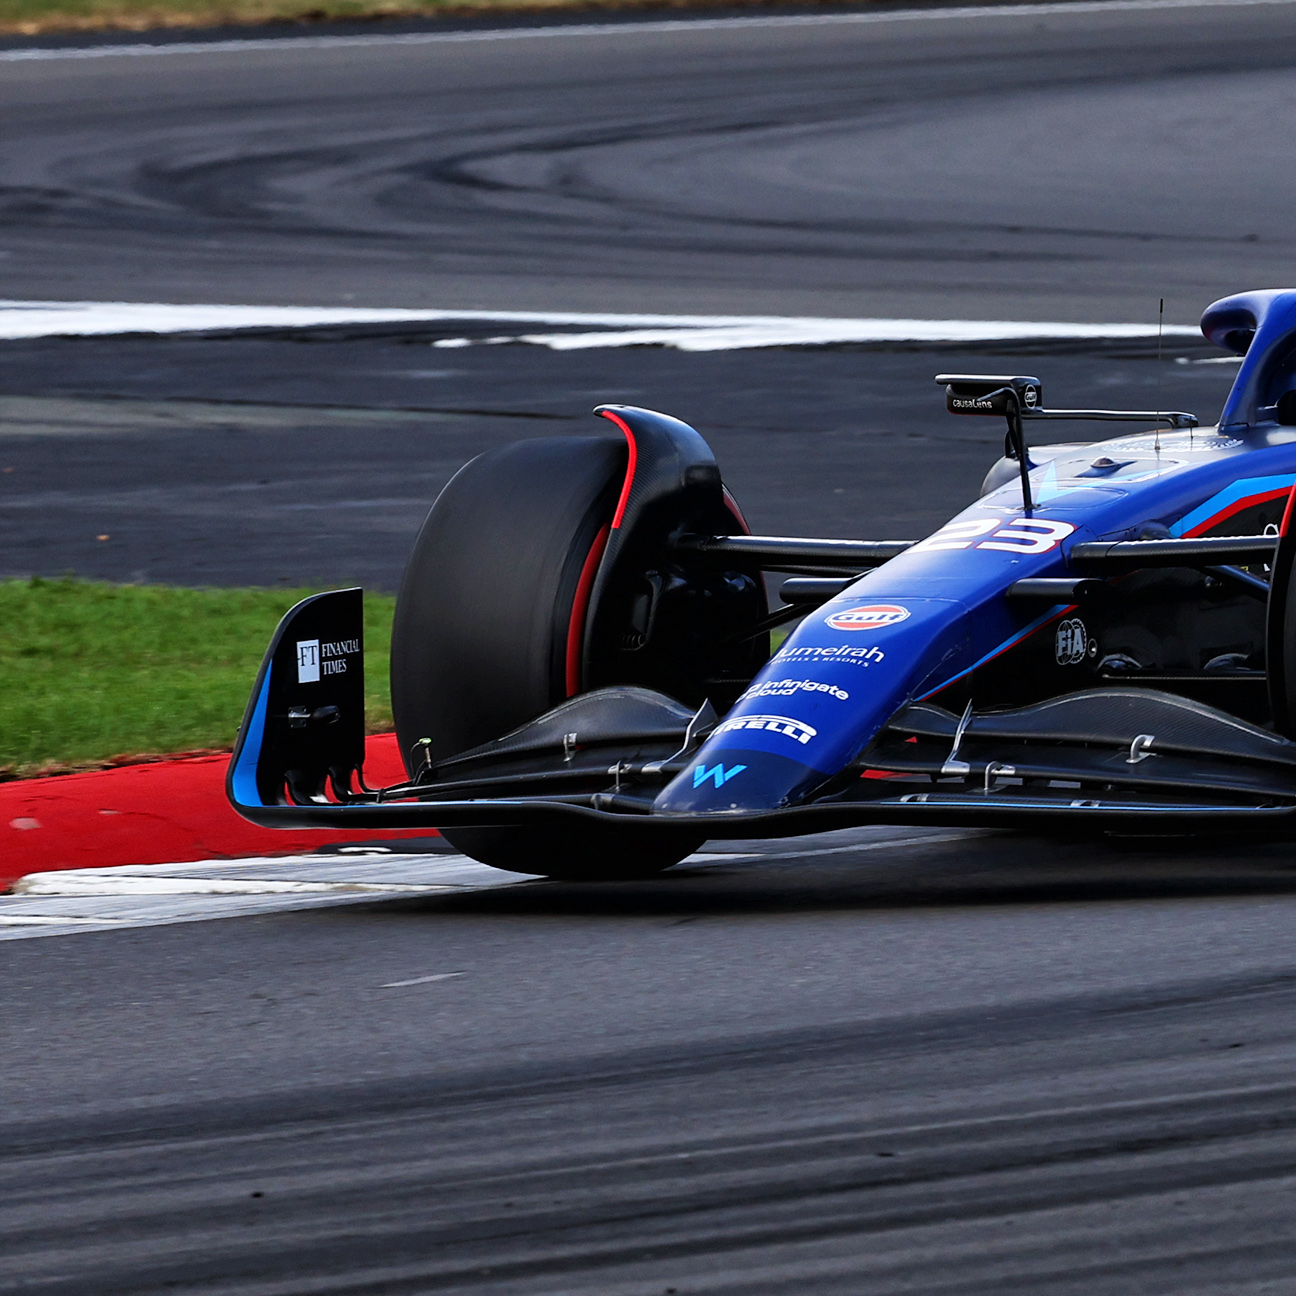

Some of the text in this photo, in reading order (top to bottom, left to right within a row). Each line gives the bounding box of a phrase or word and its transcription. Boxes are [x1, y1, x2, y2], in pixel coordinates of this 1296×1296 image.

[901, 517, 1077, 555] 23
[831, 612, 904, 624] Gulf
[297, 645, 318, 667] FT
[321, 638, 360, 657] FINANCIAL
[321, 659, 347, 676] TIMES
[745, 687, 799, 700] cloud
[763, 679, 850, 701] infinigate
